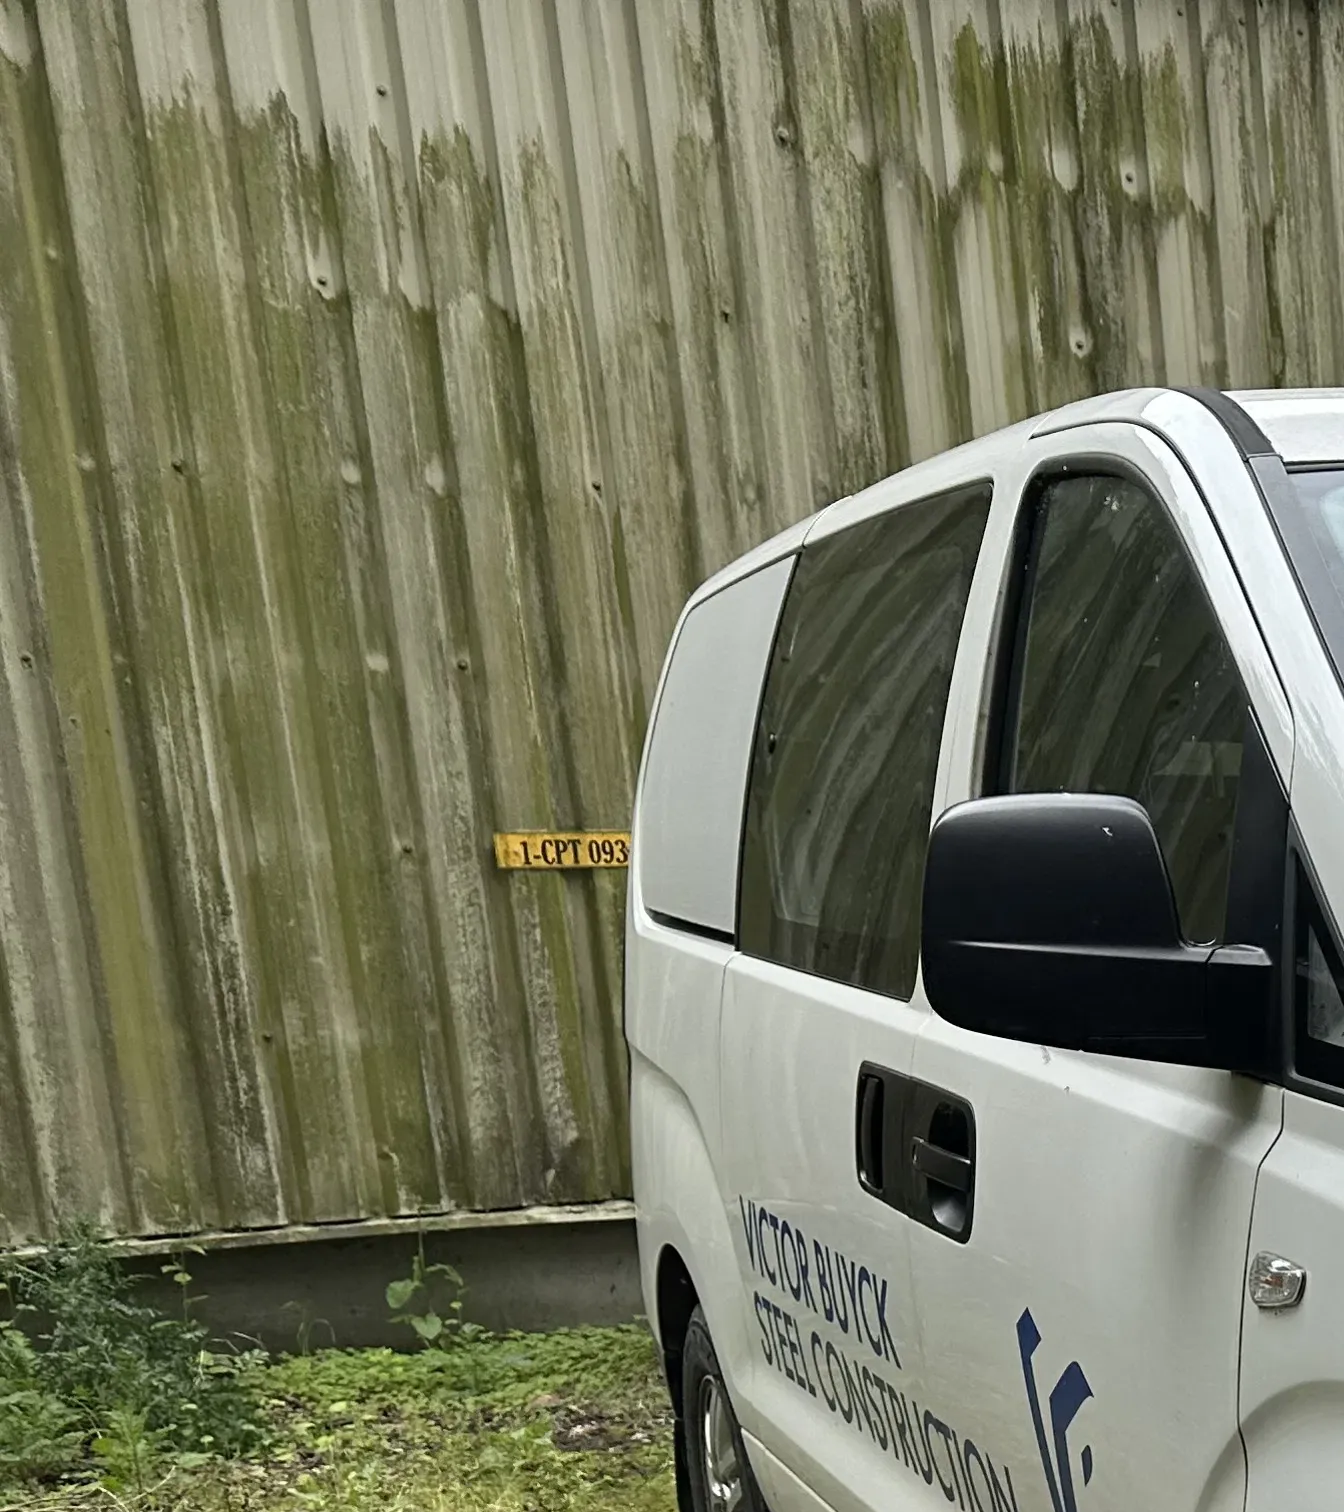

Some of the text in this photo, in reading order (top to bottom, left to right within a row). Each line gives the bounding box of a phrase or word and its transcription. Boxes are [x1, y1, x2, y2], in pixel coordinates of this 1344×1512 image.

[519, 838, 628, 865] 1-CPT 093
[739, 1194, 902, 1371] VICTOR BUYCK
[753, 1291, 817, 1399] STEEL
